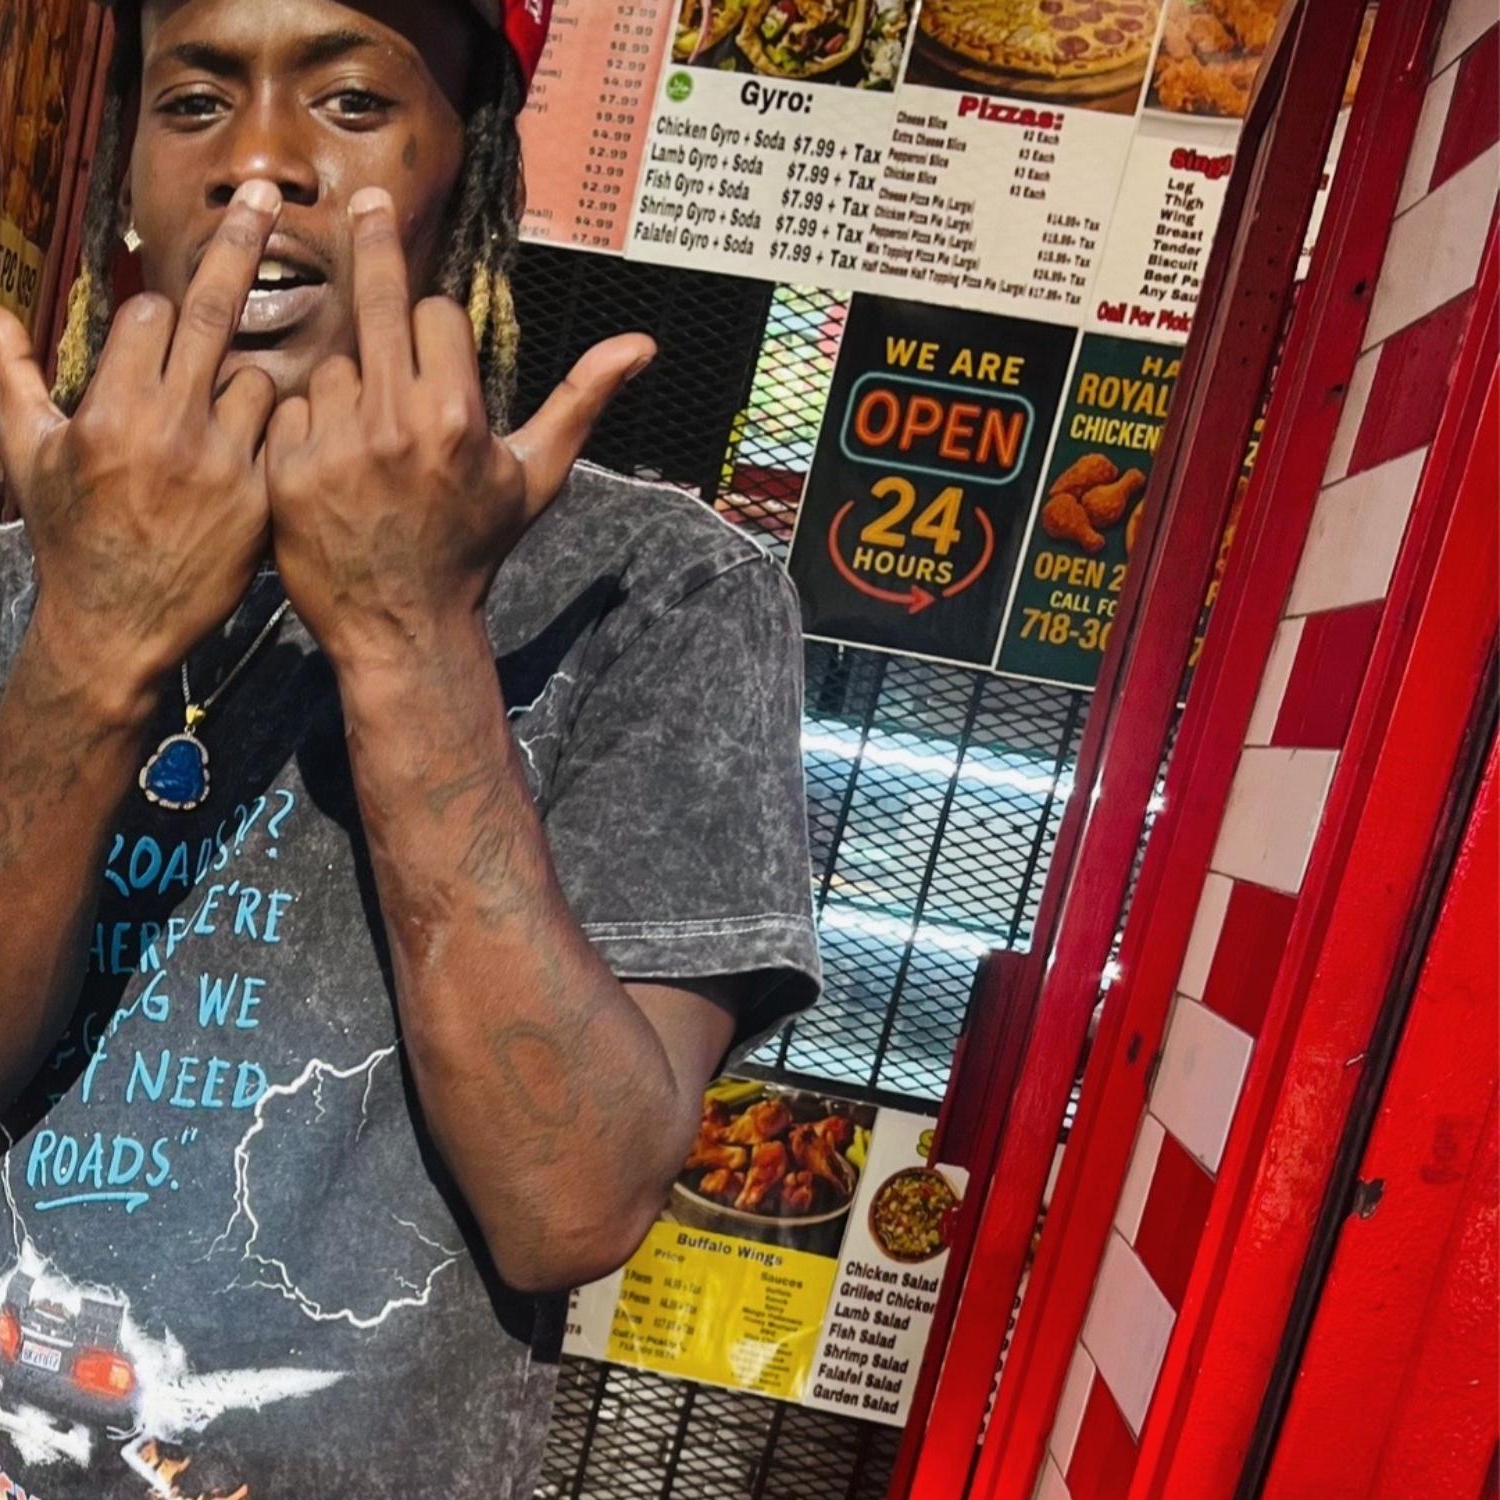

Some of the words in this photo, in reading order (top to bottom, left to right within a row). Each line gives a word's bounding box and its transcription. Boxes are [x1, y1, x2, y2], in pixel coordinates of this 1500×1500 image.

[740, 80, 814, 114] Gyro:
[958, 95, 1065, 131] Pizzas:
[657, 116, 707, 140] Chicken
[710, 124, 740, 148] Gyro
[754, 130, 786, 151] Soda
[793, 136, 835, 158] $7.99
[854, 144, 882, 164] Tax
[651, 144, 685, 165] Lamb
[688, 148, 718, 171] Gyro
[732, 154, 763, 175] Soda
[787, 162, 829, 185] $7.99
[848, 170, 876, 191] Tax
[645, 169, 671, 189] Fish
[674, 174, 703, 197] Gyro
[718, 180, 750, 200] Soda
[781, 189, 823, 211] $7.99
[842, 196, 870, 218] Tax
[1164, 193, 1204, 210] Thigh
[1168, 177, 1195, 195] Leg
[1156, 224, 1204, 241] Breast
[1160, 209, 1195, 227] Wing
[1148, 254, 1198, 272] Biscuit
[1153, 239, 1202, 256] Tender
[1097, 300, 1127, 323] Call
[1129, 305, 1155, 326] For
[885, 336, 940, 372] WE
[949, 348, 1026, 386] ARE
[1076, 372, 1171, 419] ROYAL
[853, 387, 1025, 470] OPEN
[1069, 413, 1158, 452] CHICKEN
[860, 476, 965, 556] 24
[852, 547, 954, 585] HOURS
[1033, 551, 1106, 588] OPEN
[1050, 590, 1094, 616] CALL
[198, 972, 267, 1029] WE
[126, 1049, 268, 1110] NEED
[676, 1232, 733, 1258] Buffalo
[737, 1246, 784, 1268] Wings
[760, 1270, 804, 1289] Sauces
[840, 1282, 884, 1303] Grilled
[845, 1260, 899, 1285] Chicken
[901, 1272, 940, 1294] Salad
[834, 1302, 870, 1322] Lamb
[873, 1310, 911, 1331] Salad
[829, 1322, 856, 1341] Fish
[859, 1329, 897, 1350] Salad
[823, 1343, 869, 1366] Shrimp
[872, 1353, 909, 1374] Salad
[818, 1363, 863, 1385] Falafel
[865, 1373, 902, 1394] Salad
[813, 1384, 859, 1406] Garden
[862, 1394, 899, 1415] Salad
